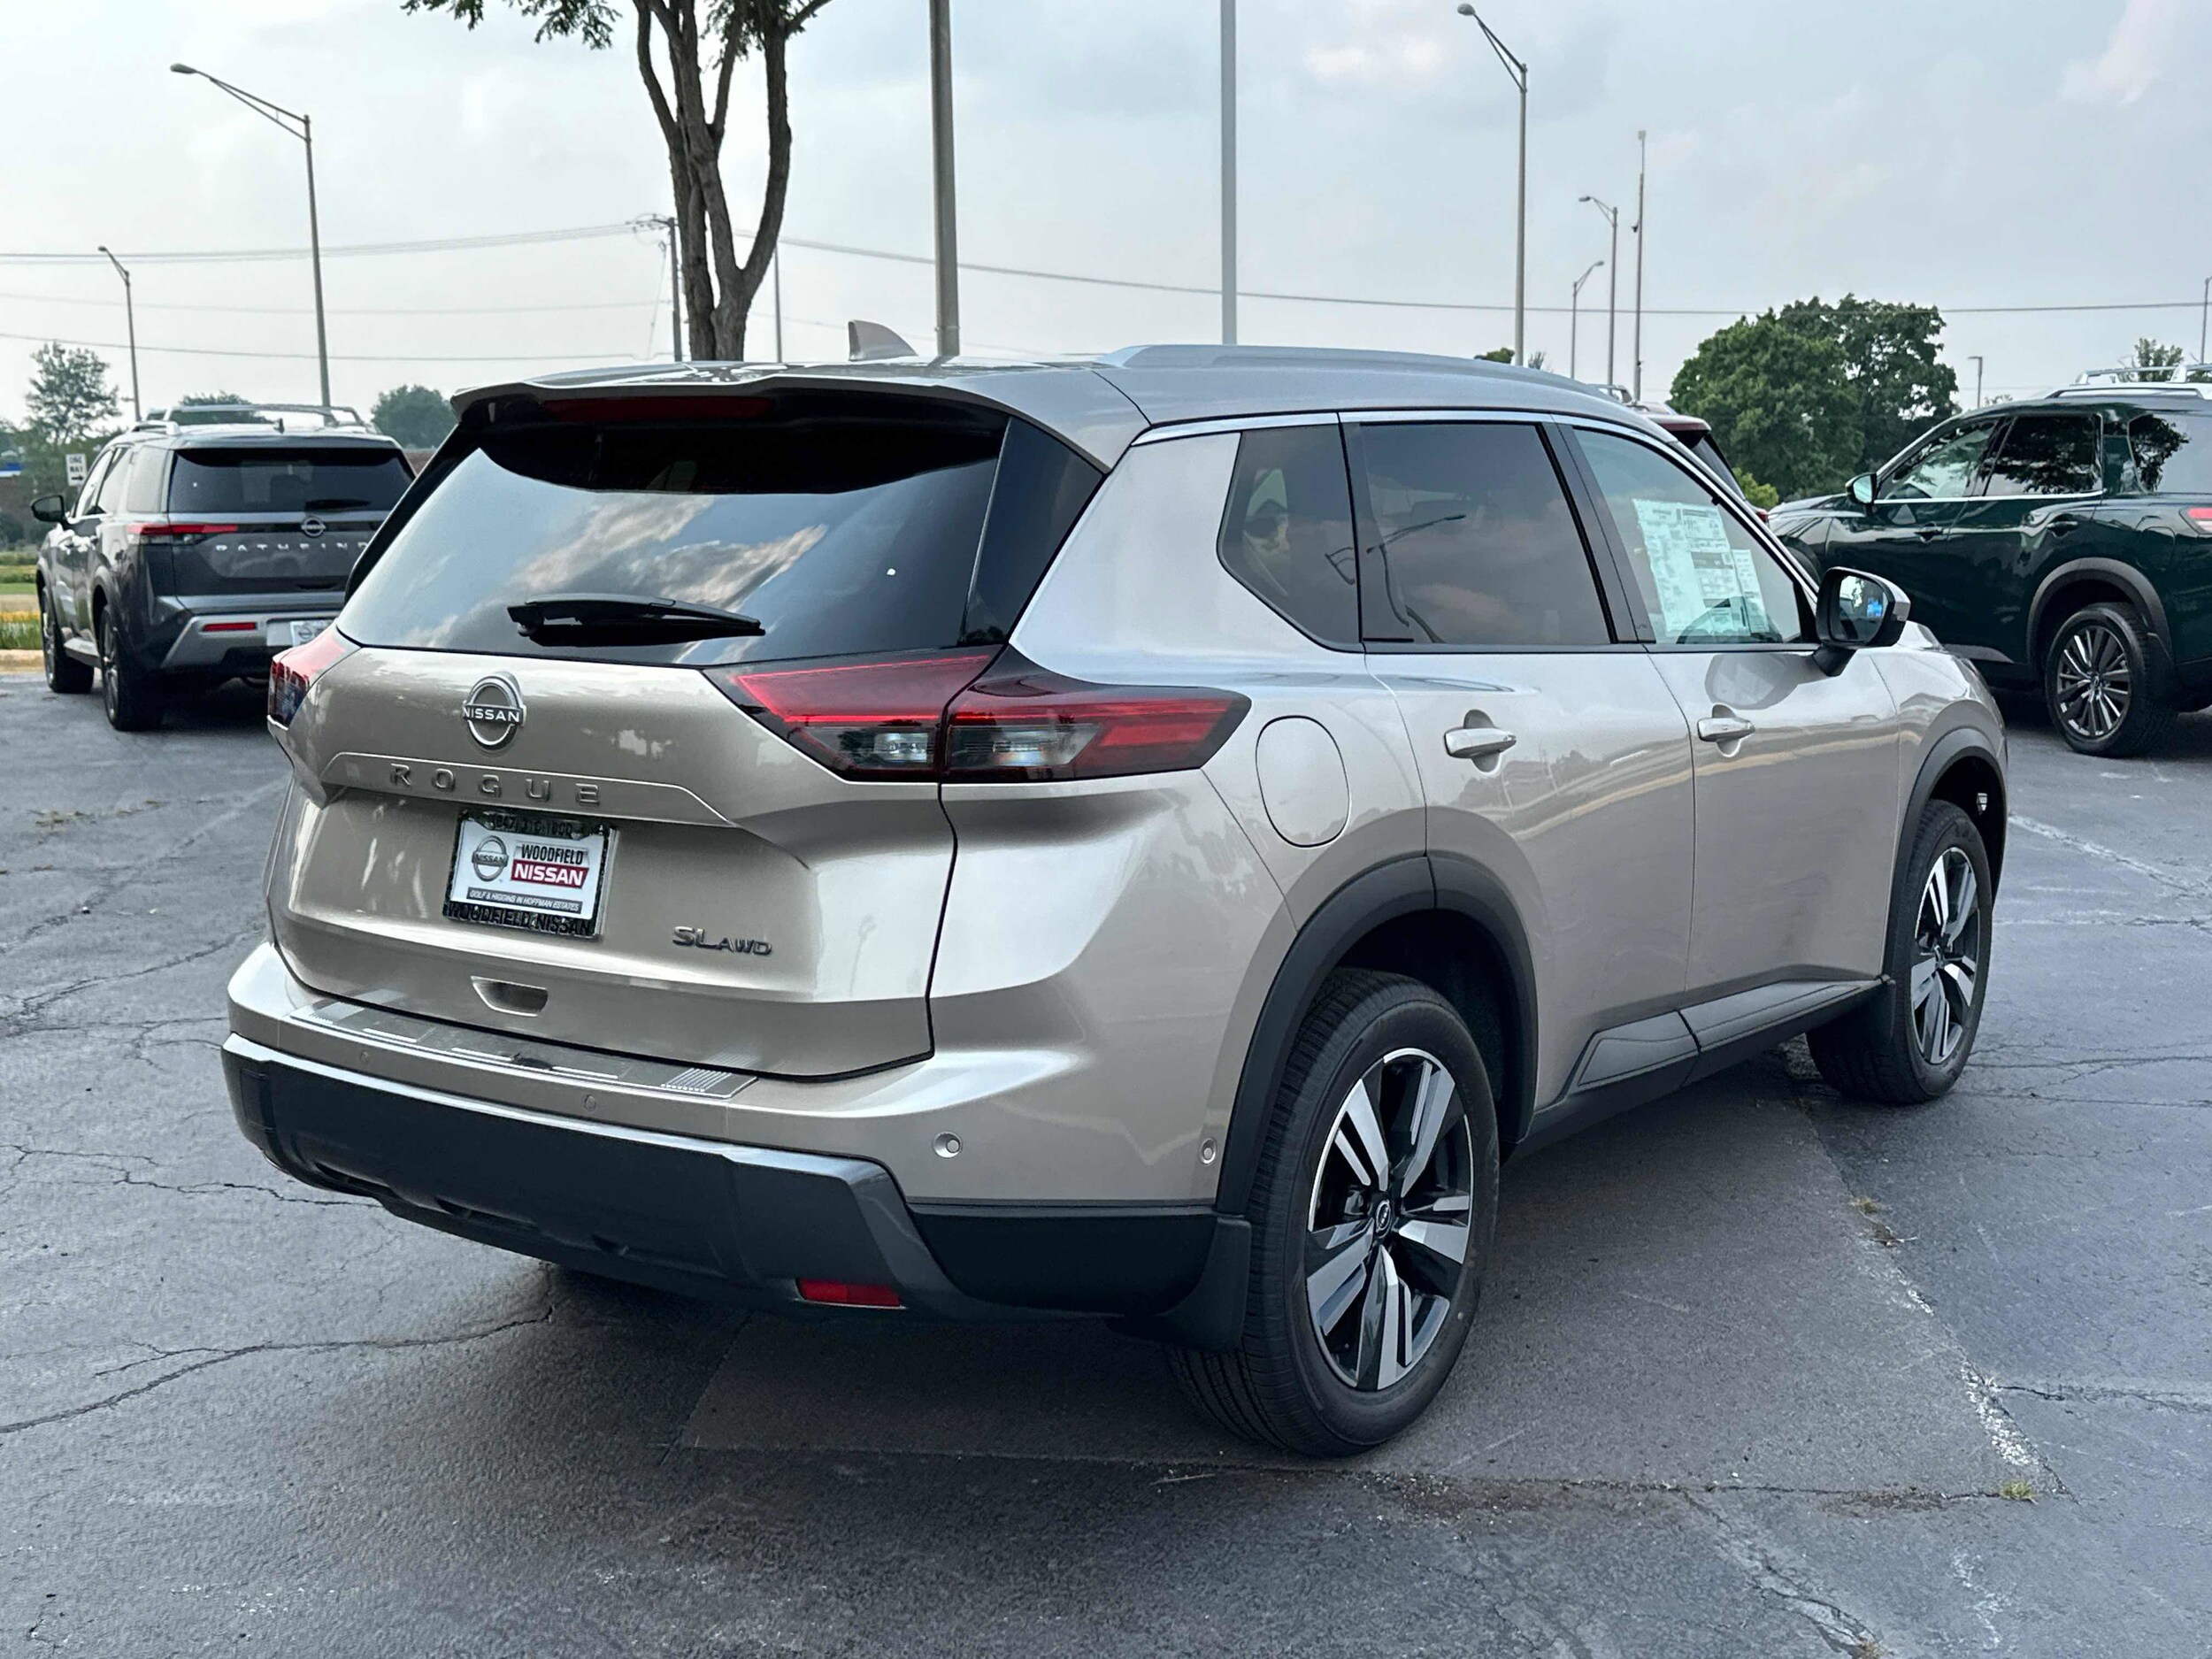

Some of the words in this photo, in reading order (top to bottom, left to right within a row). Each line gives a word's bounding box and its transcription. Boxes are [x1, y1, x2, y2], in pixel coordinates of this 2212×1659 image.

[463, 707, 520, 723] NISSAN
[390, 763, 600, 805] ROGUE
[521, 844, 584, 865] WOODFIELD
[514, 863, 584, 887] NISSAN
[672, 926, 719, 949] SL
[718, 937, 772, 956] AWD
